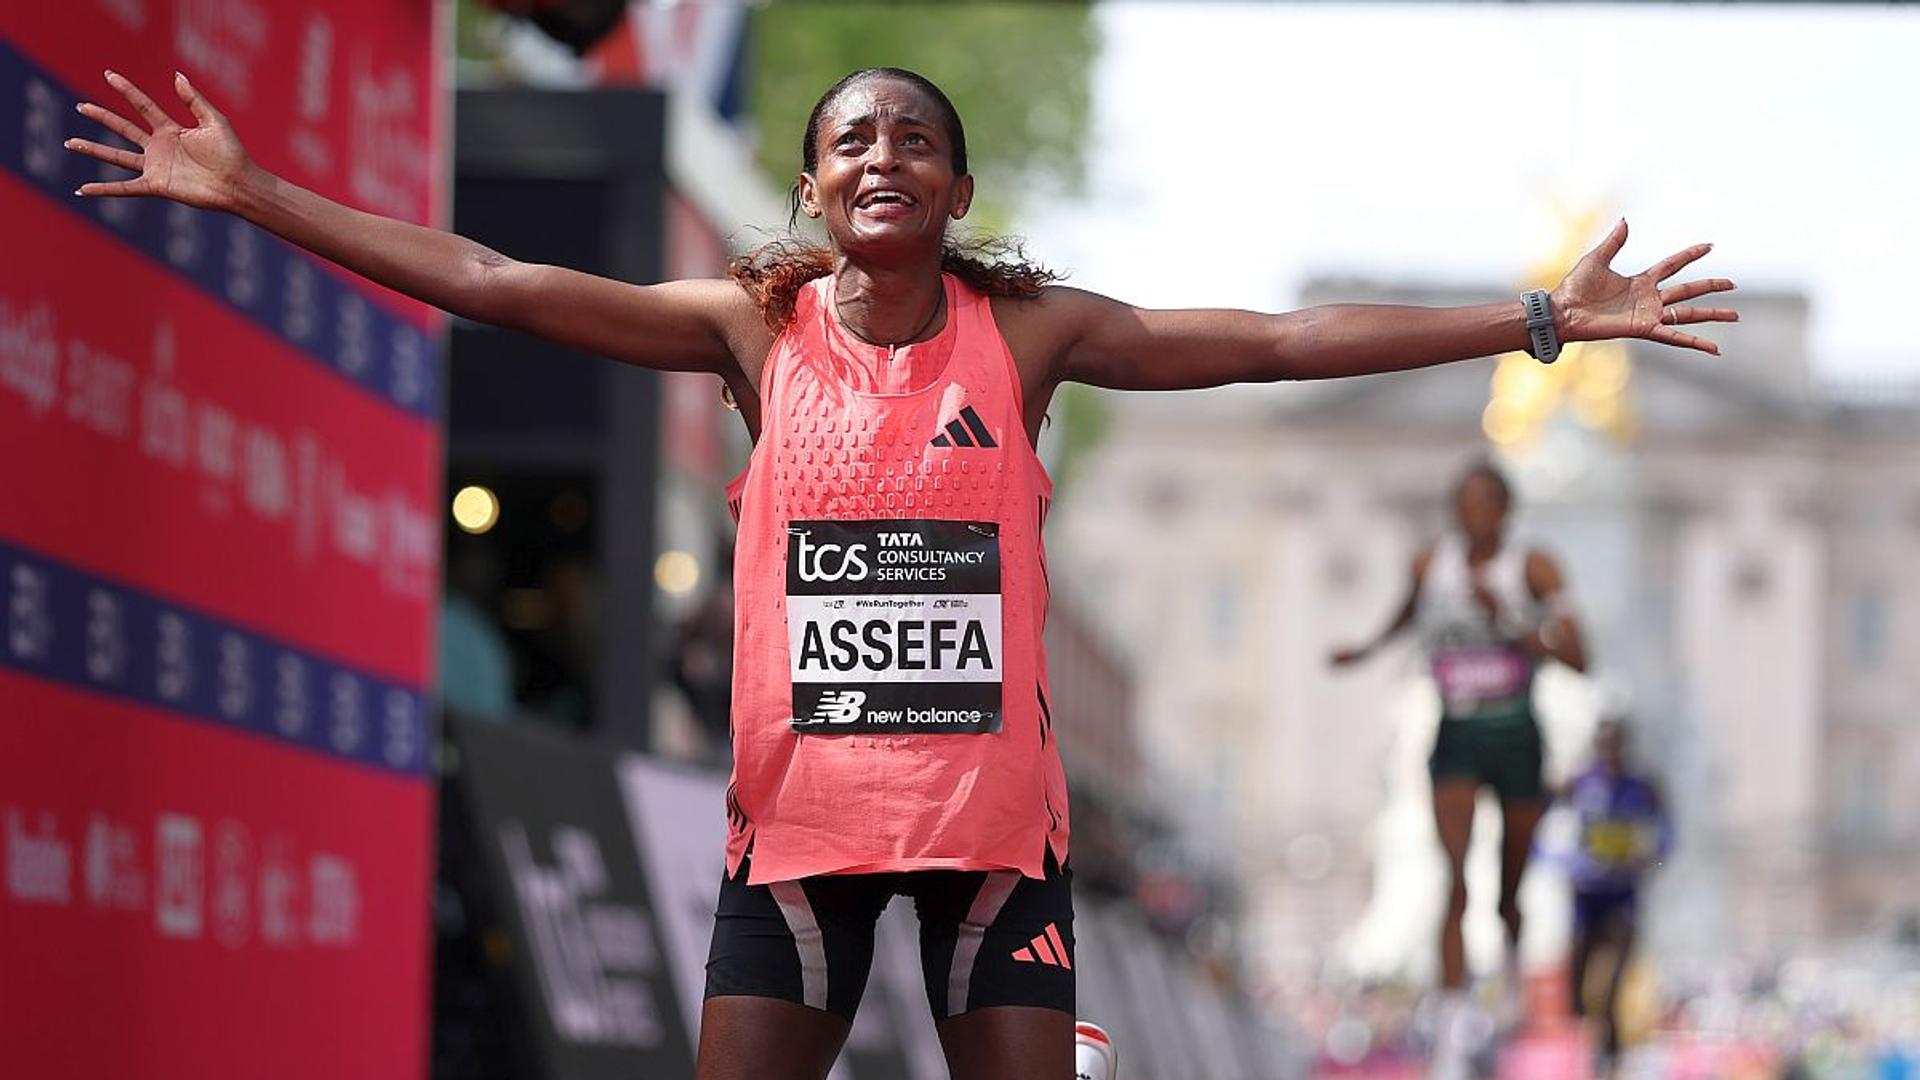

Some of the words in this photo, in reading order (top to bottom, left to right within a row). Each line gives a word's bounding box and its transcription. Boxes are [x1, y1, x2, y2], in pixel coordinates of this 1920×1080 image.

[876, 532, 923, 547] TATA
[798, 531, 868, 582] tcs
[877, 550, 986, 565] CONSULTANCY
[877, 567, 947, 581] SERVICES
[798, 619, 994, 672] ASSEFA
[867, 710, 903, 724] new
[907, 707, 982, 724] balance
